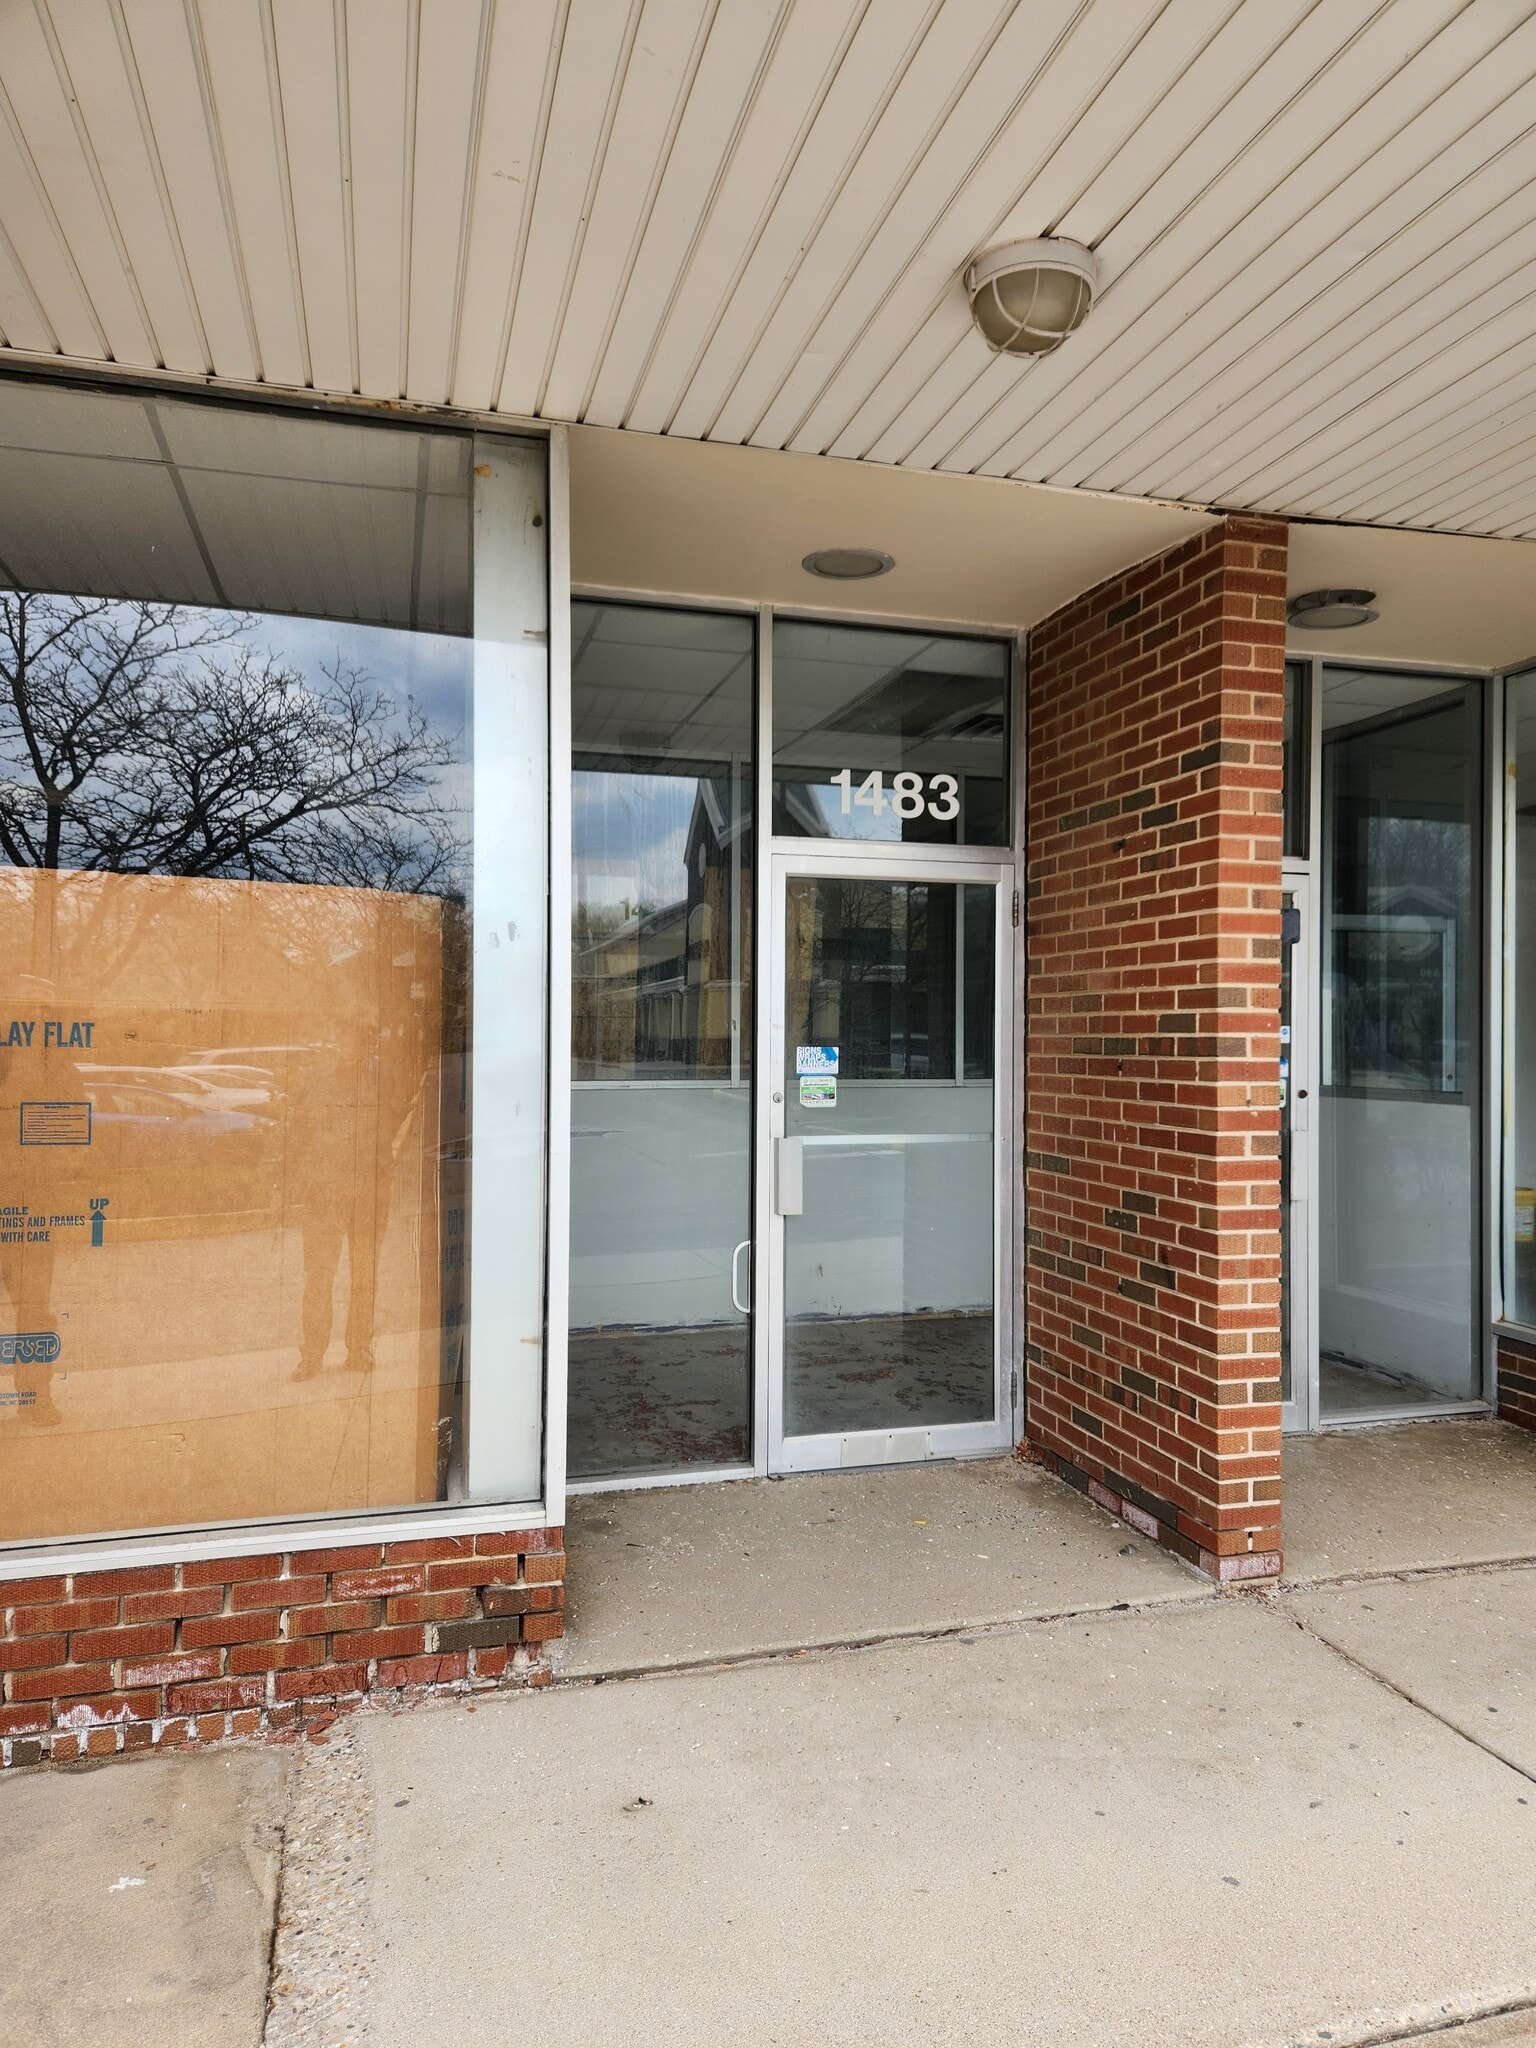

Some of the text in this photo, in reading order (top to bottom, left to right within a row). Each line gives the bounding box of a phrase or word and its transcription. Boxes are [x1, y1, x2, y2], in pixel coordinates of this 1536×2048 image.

[830, 769, 960, 820] 1483
[0, 1021, 95, 1048] LAY FLAT
[797, 1046, 821, 1054] SIGNS
[89, 1198, 109, 1210] UP
[27, 1216, 46, 1227] AND
[49, 1215, 85, 1226] FRAMES
[1, 1230, 50, 1242] WITH CARE
